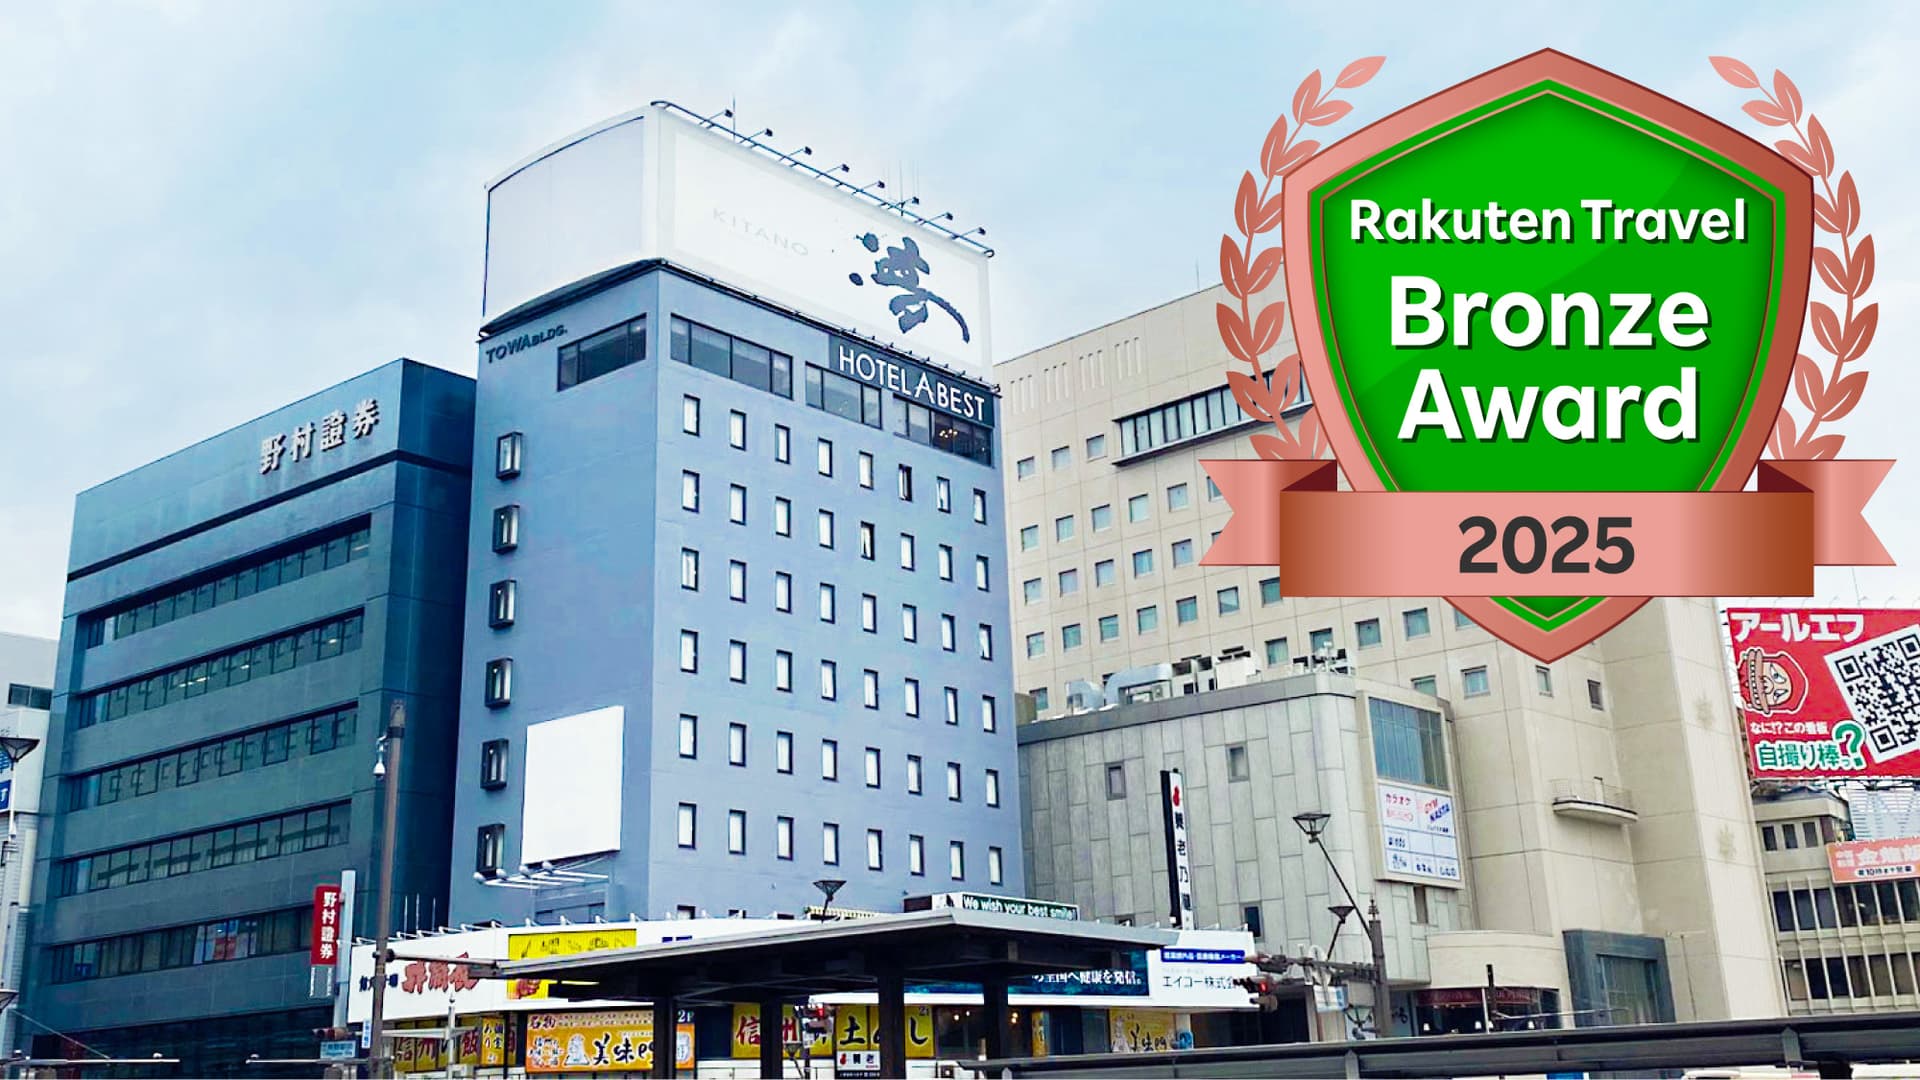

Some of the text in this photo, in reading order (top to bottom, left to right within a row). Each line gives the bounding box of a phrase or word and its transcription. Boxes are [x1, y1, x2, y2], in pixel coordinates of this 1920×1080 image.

[713, 207, 809, 256] KITANO
[486, 324, 568, 364] TOWA BLDG.
[838, 345, 911, 398] HOTEL
[259, 398, 380, 475] 野村證券
[1730, 612, 1865, 643] アールエフ
[319, 891, 338, 960] 野村證券
[963, 895, 978, 910] We
[981, 899, 1003, 913] wish
[1004, 901, 1026, 915] your
[1027, 902, 1048, 917] best
[1163, 976, 1235, 989] エイコー株式会
